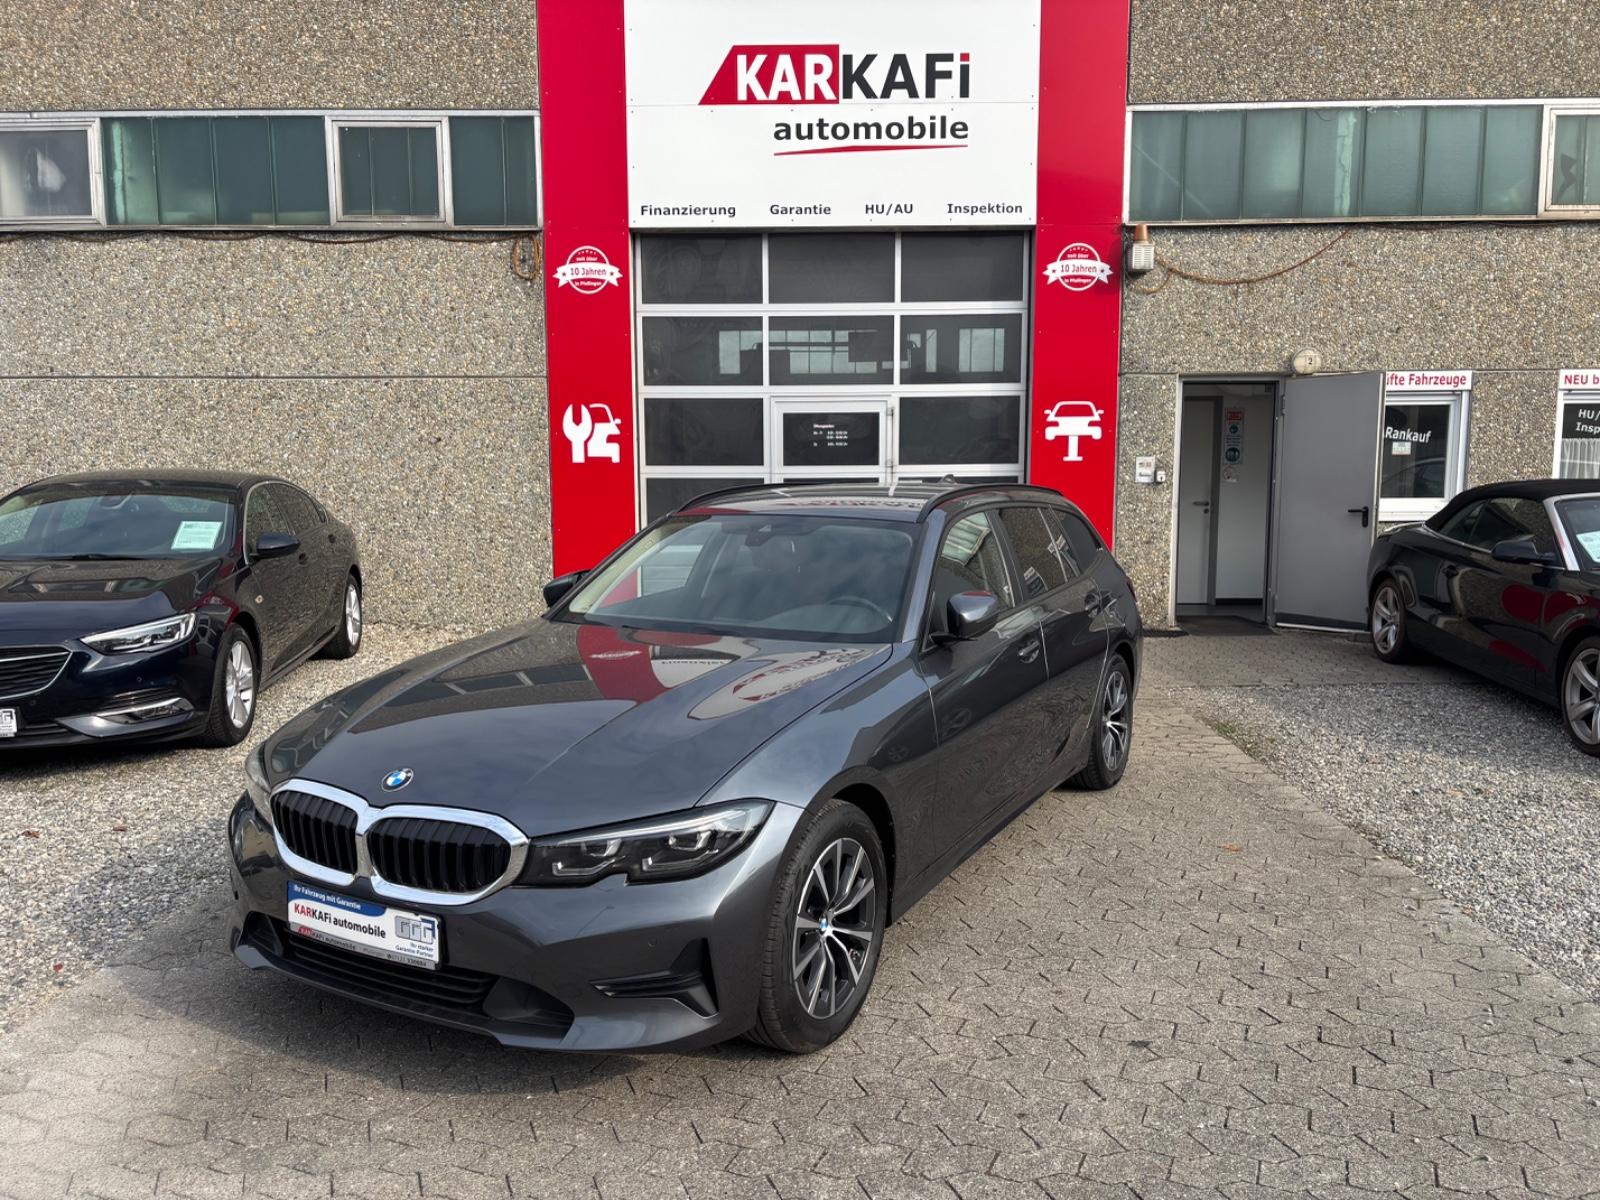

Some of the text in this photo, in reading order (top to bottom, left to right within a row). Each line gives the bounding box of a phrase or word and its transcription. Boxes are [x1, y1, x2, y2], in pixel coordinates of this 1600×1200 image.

[736, 52, 970, 101] KARKAFi
[773, 115, 969, 141] automobile
[640, 202, 1023, 217] Finanzierung Garantie HU/AU Inspektion
[570, 267, 607, 276] 10 Jahren
[1060, 264, 1098, 273] 10 Jahren
[1408, 373, 1467, 388] Fahrzeuge
[1564, 374, 1589, 385] NEU
[301, 886, 326, 901] Fahrzeug
[326, 894, 336, 903] mit
[336, 896, 361, 910] Garantie
[294, 902, 387, 939] KARKAFi automobile
